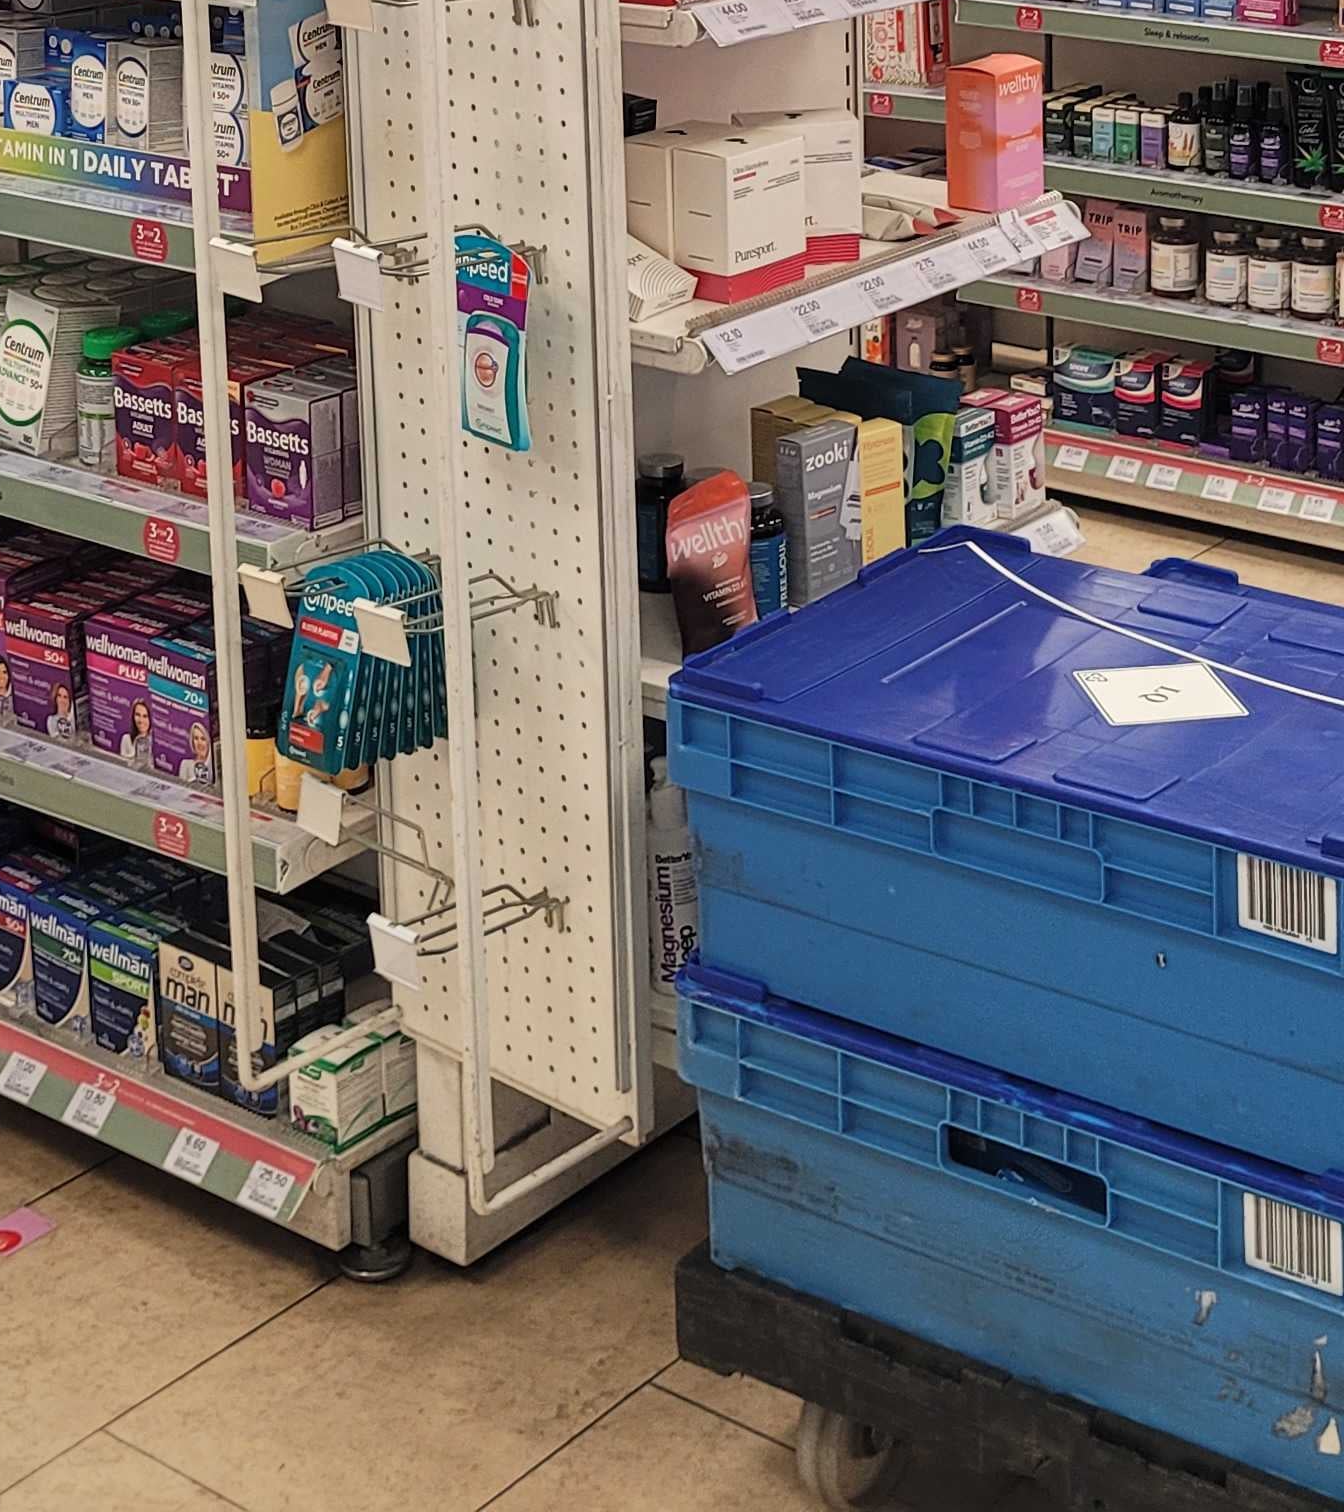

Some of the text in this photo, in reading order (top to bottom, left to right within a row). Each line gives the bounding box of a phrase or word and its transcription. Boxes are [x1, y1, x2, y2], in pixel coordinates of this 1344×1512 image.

[13, 92, 50, 109] Centrum
[48, 145, 65, 165] IN
[83, 149, 144, 182] DAILY
[3, 335, 45, 363] Centrum
[114, 386, 172, 421] Bassetts
[247, 422, 309, 456] Bassetts
[5, 619, 66, 650] wellwoman
[86, 633, 147, 666] wellwoman
[44, 650, 65, 665] 50+
[118, 666, 146, 682] PLUS
[148, 655, 206, 690] wellwoman
[183, 690, 204, 705] 70+
[656, 866, 679, 983] Magnesium
[90, 941, 150, 980] wellman
[166, 977, 210, 1012] man
